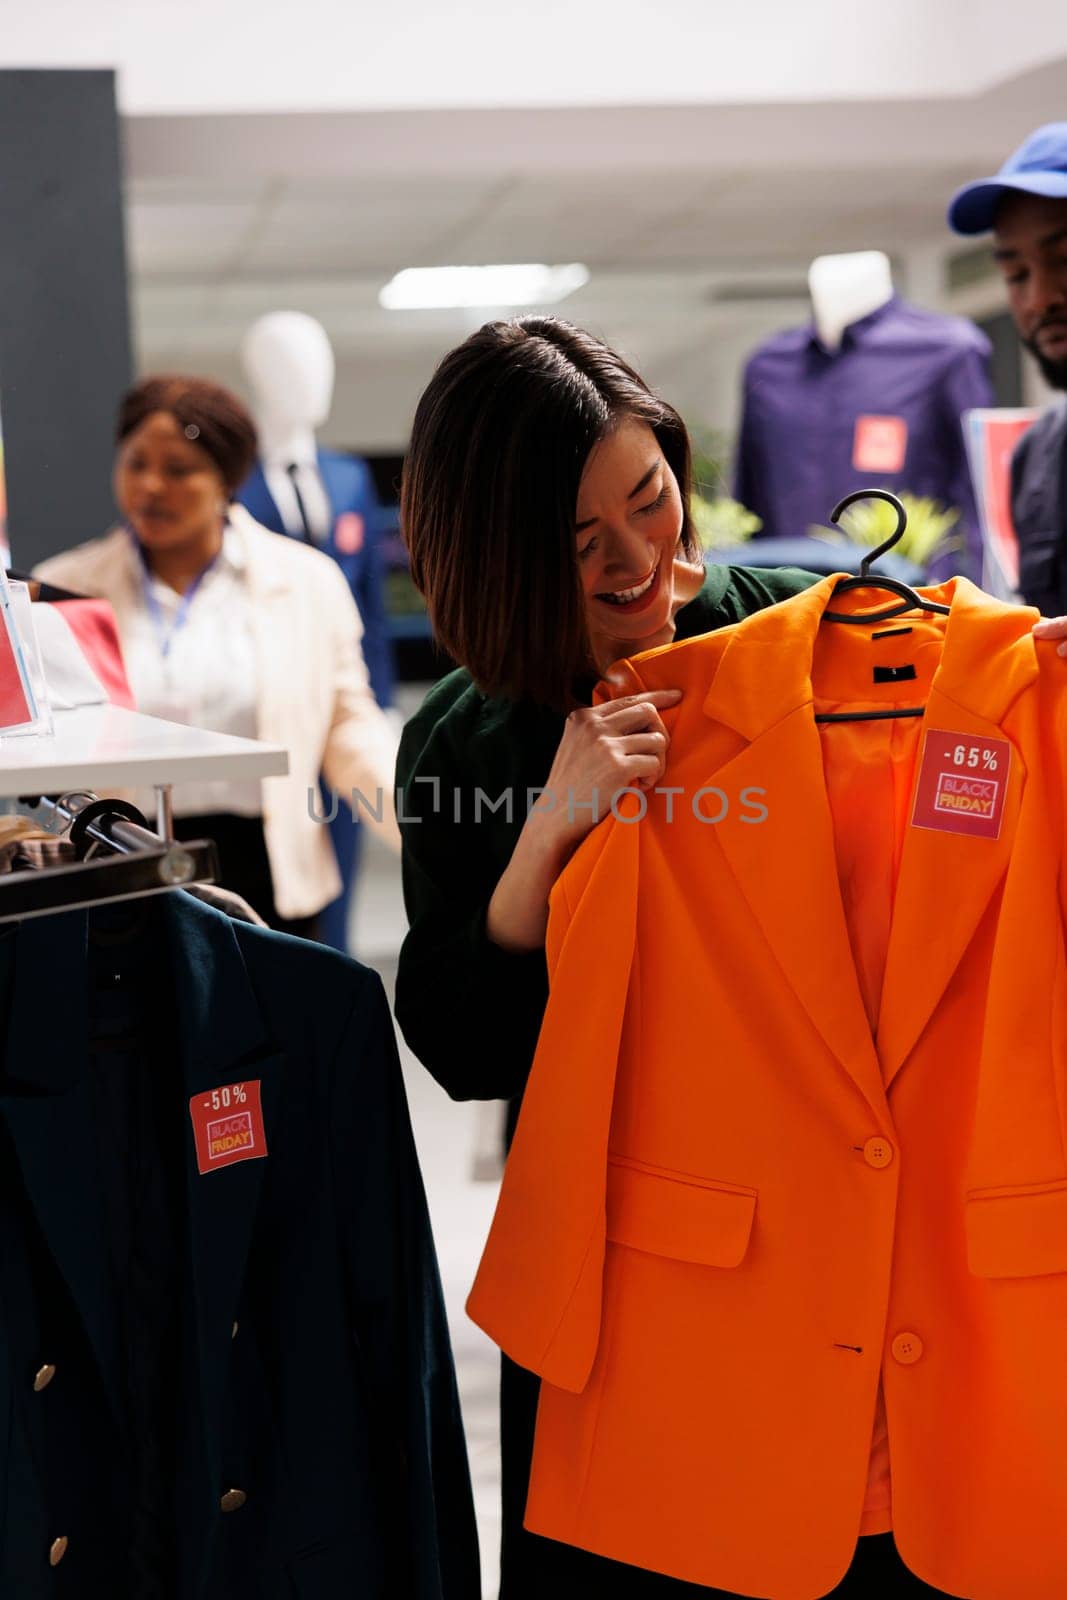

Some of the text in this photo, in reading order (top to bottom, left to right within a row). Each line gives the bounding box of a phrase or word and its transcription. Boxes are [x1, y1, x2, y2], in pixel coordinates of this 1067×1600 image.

[943, 745, 998, 771] -65%
[943, 779, 992, 799] BLACK
[939, 793, 993, 813] FRIDAY
[203, 1084, 247, 1110] -50%
[211, 1117, 248, 1138] BLACK
[211, 1131, 250, 1154] FRIDAY
